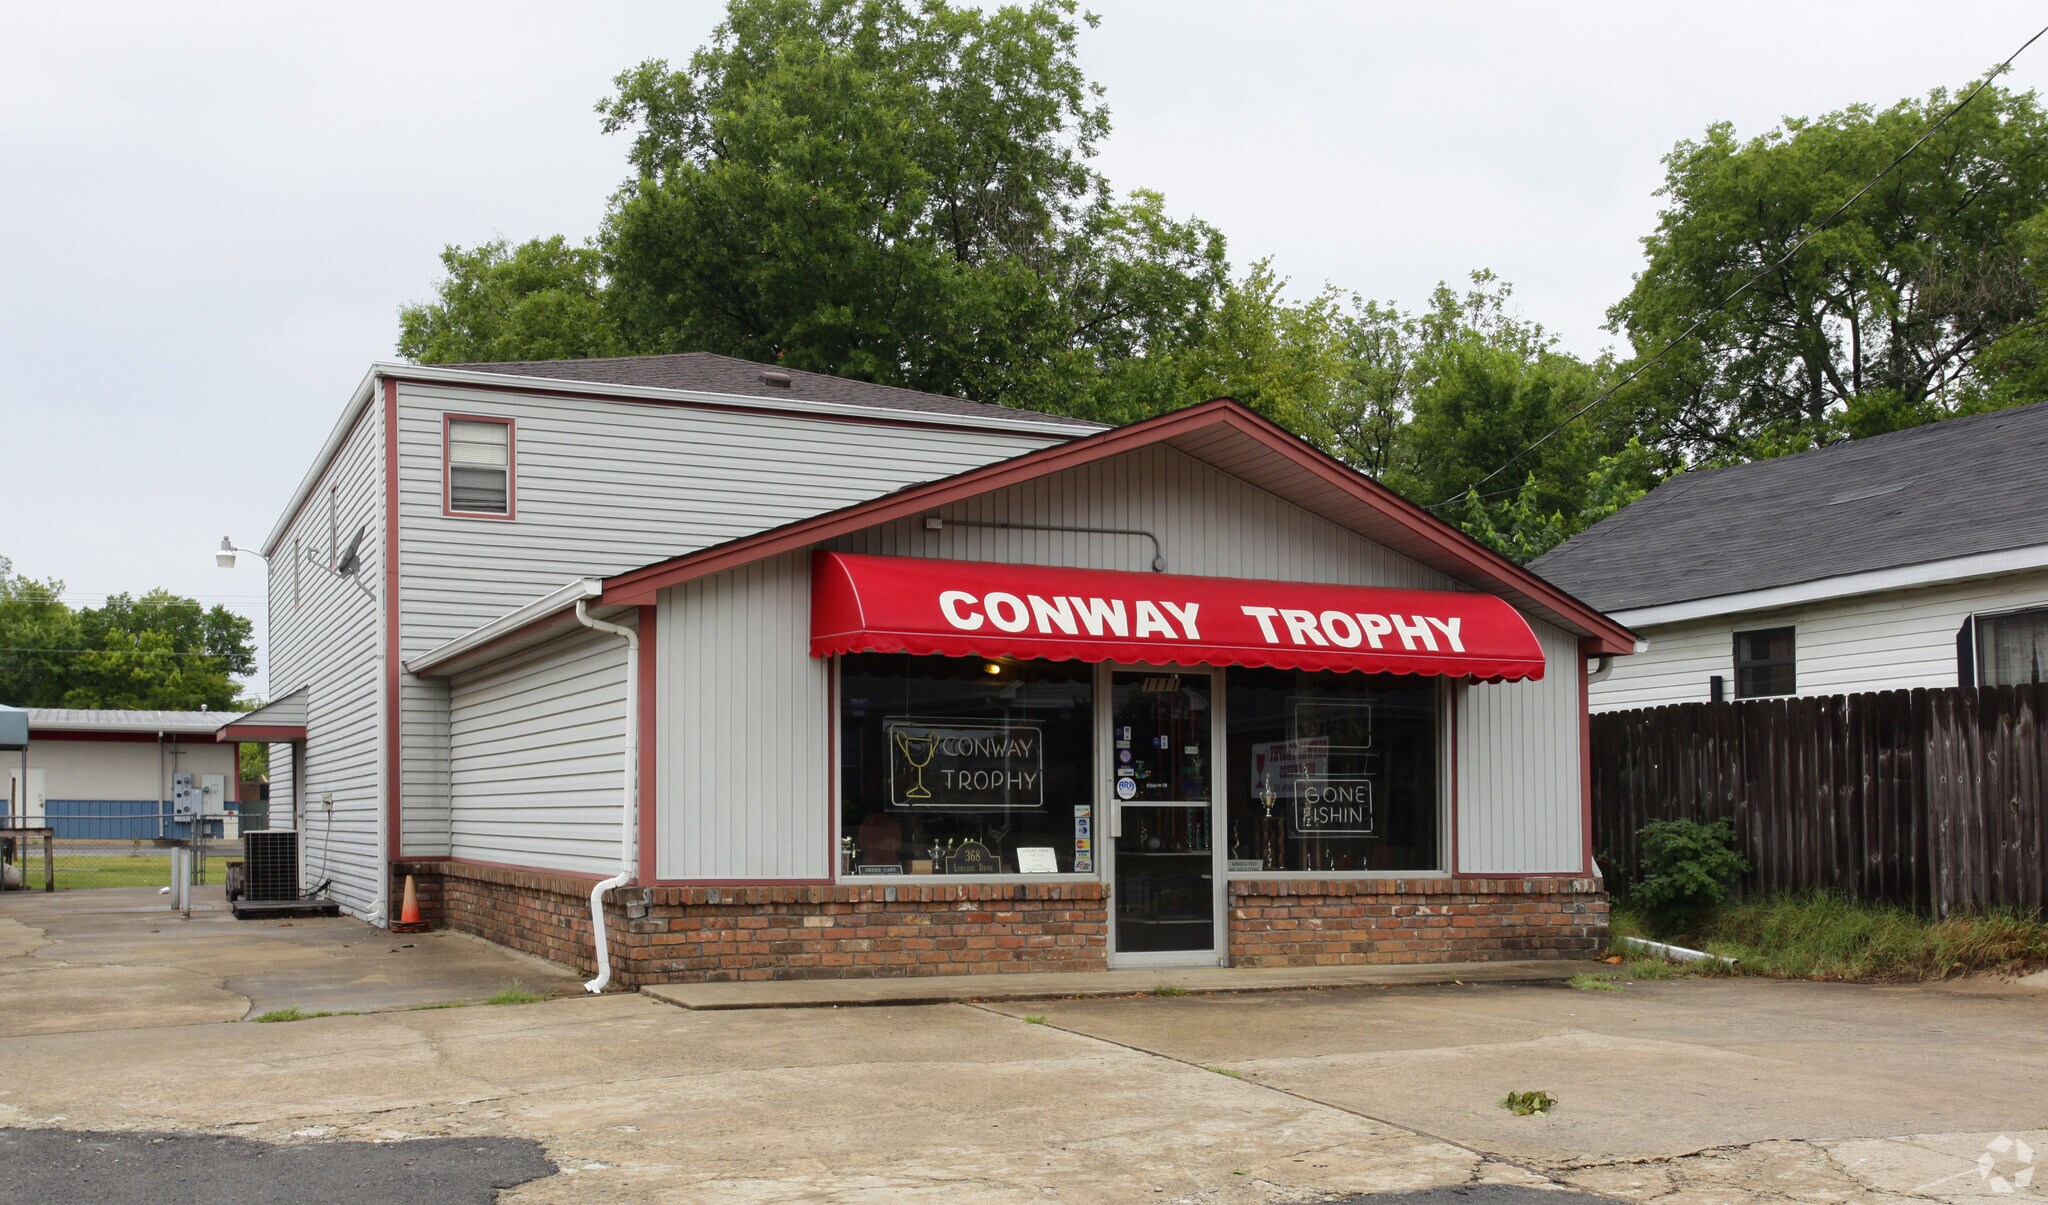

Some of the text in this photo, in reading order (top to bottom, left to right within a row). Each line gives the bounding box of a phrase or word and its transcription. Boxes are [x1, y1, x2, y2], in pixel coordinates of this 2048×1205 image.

[939, 590, 1465, 652] CONWAY TROPHY
[942, 737, 1033, 758] CONWAY
[941, 769, 1037, 790] TROPHY
[1305, 786, 1365, 804] GONE
[1303, 807, 1362, 824] FISHIN
[965, 850, 981, 862] 368
